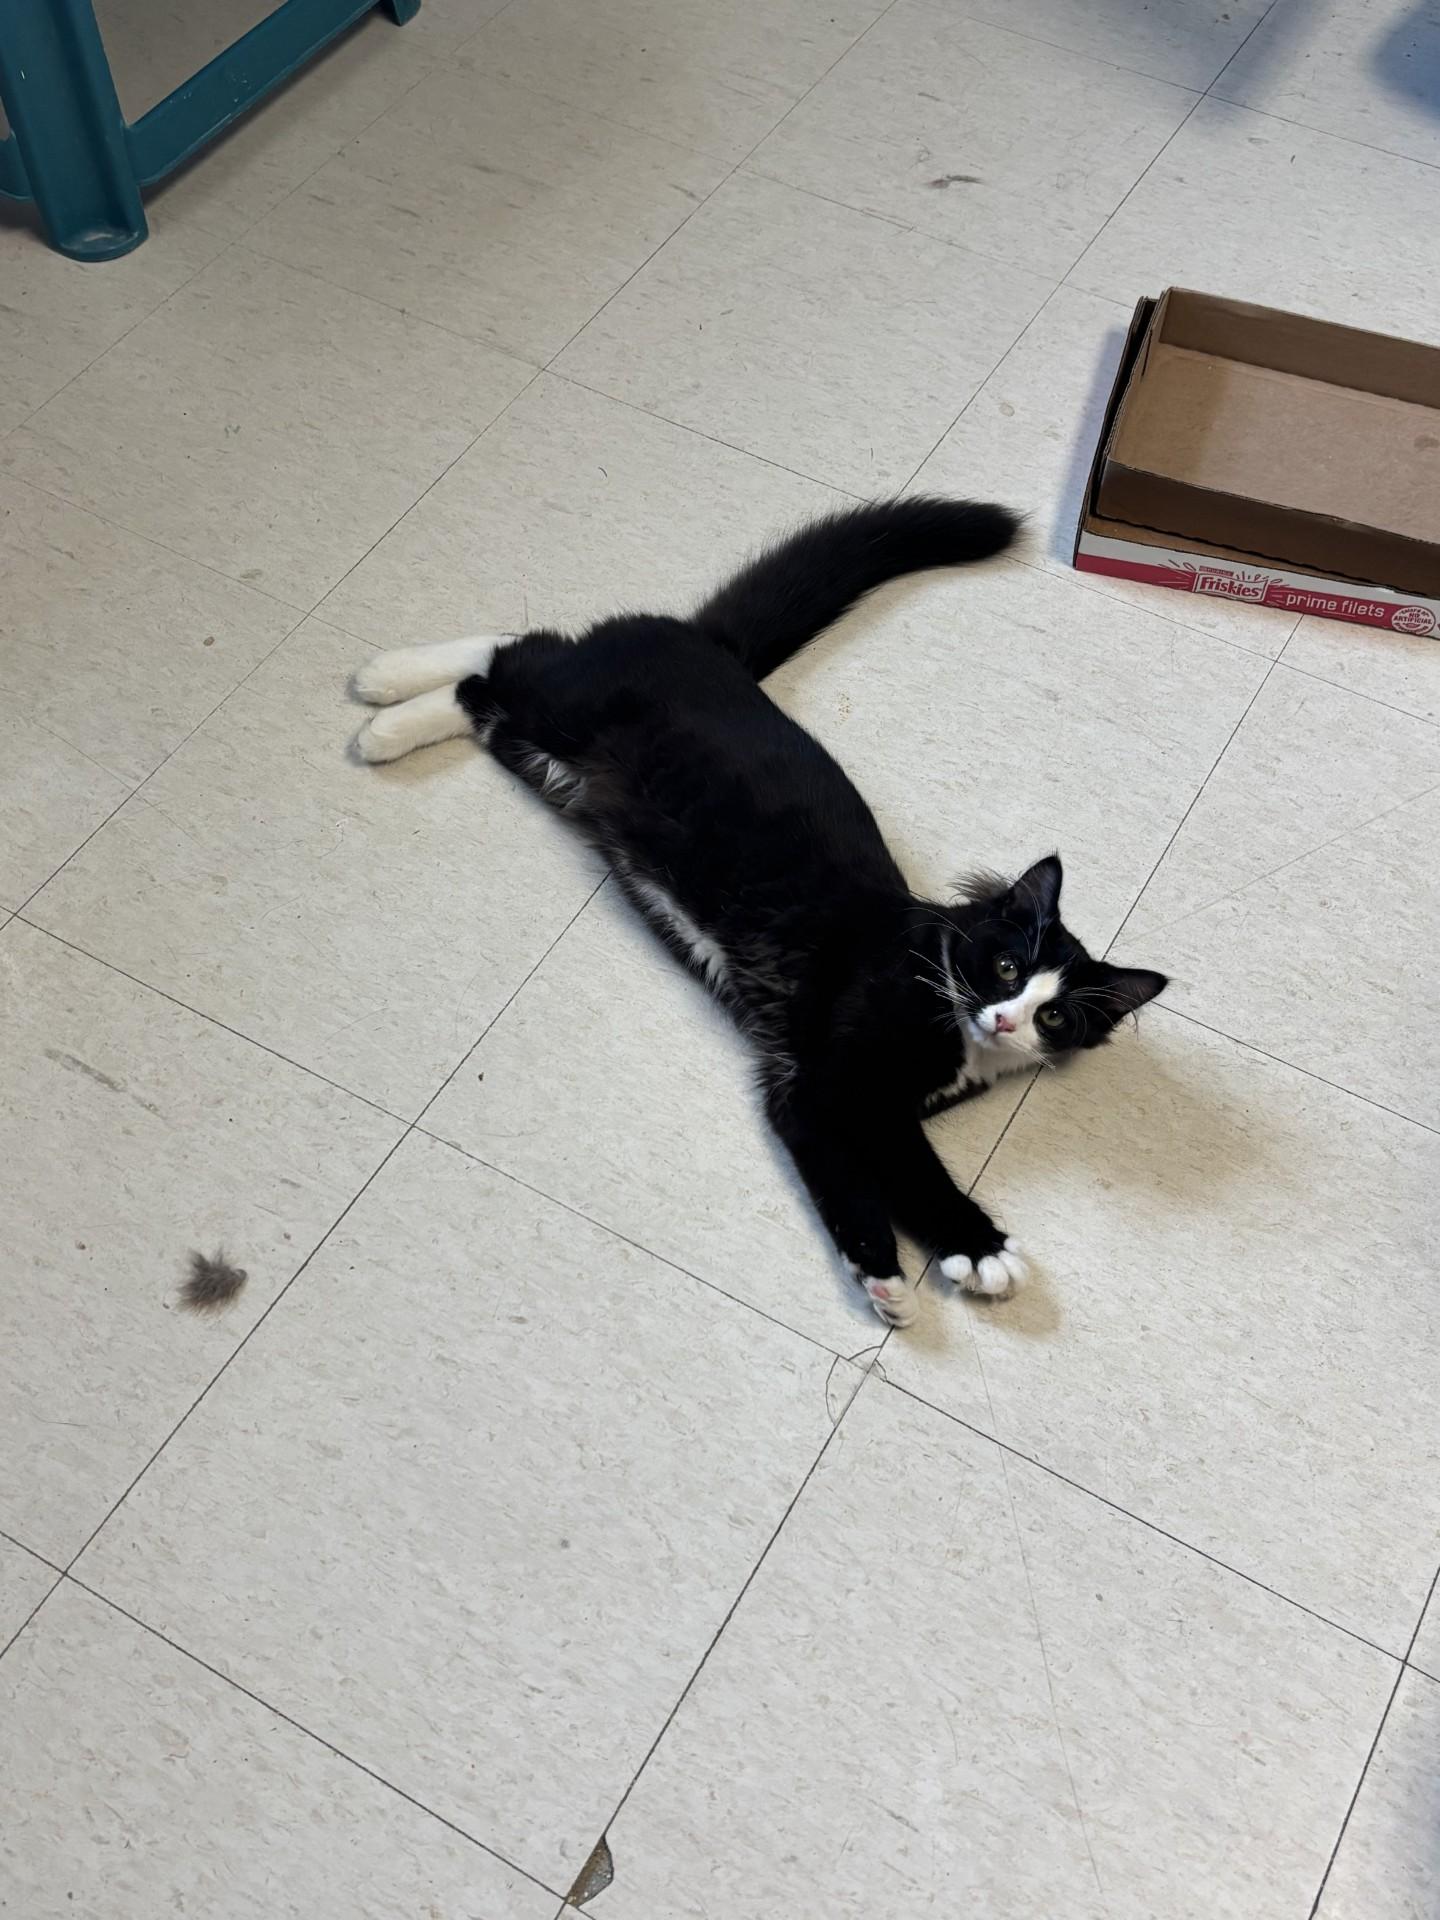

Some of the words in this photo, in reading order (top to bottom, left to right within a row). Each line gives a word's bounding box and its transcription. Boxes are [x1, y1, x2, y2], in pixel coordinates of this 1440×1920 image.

[1200, 576, 1262, 597] Friskies
[1286, 594, 1337, 611] prime
[1341, 600, 1385, 618] filets
[1393, 615, 1433, 625] ARTIFICIAL
